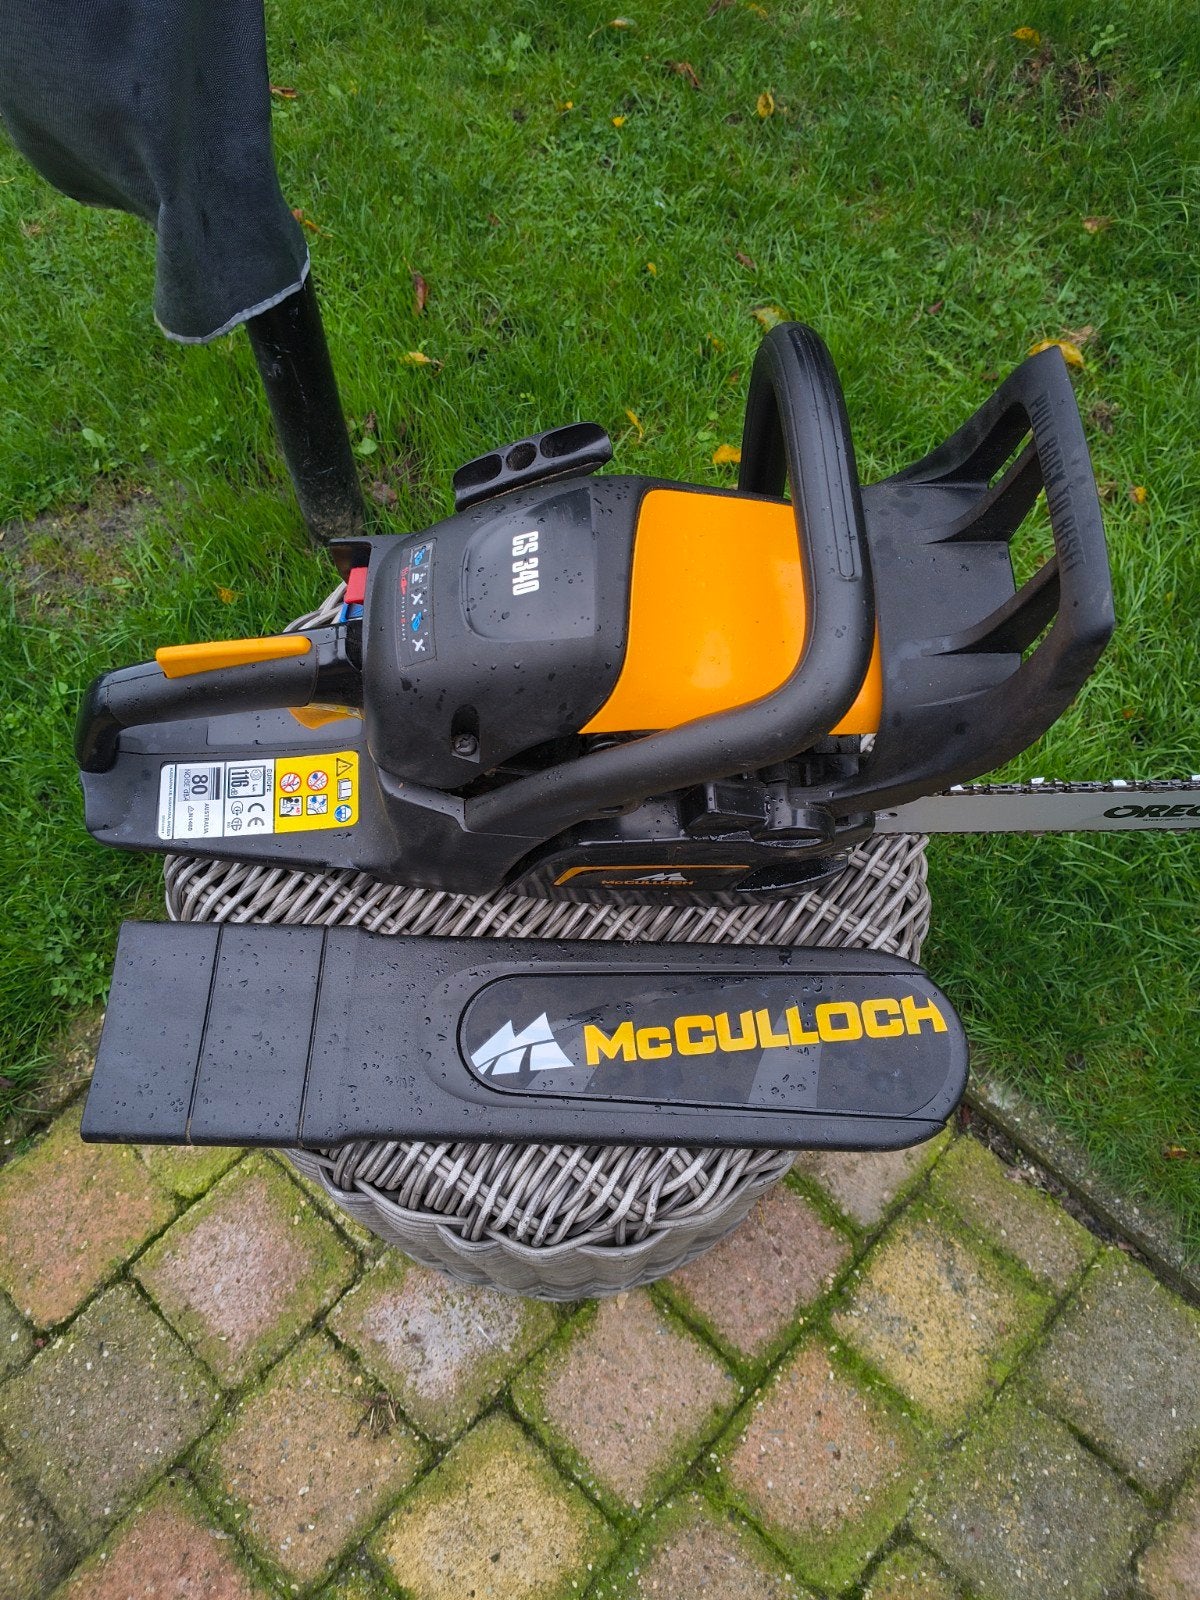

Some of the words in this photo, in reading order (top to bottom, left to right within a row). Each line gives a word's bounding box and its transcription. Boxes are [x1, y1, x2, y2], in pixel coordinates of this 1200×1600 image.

[1039, 437, 1066, 491] BACK
[1055, 518, 1085, 573] RESET
[512, 531, 539, 557] CS
[512, 557, 540, 596] 340
[191, 774, 208, 795] 80
[231, 769, 250, 788] 116
[247, 802, 265, 828] CE
[583, 995, 948, 1066] McCULLOCH
